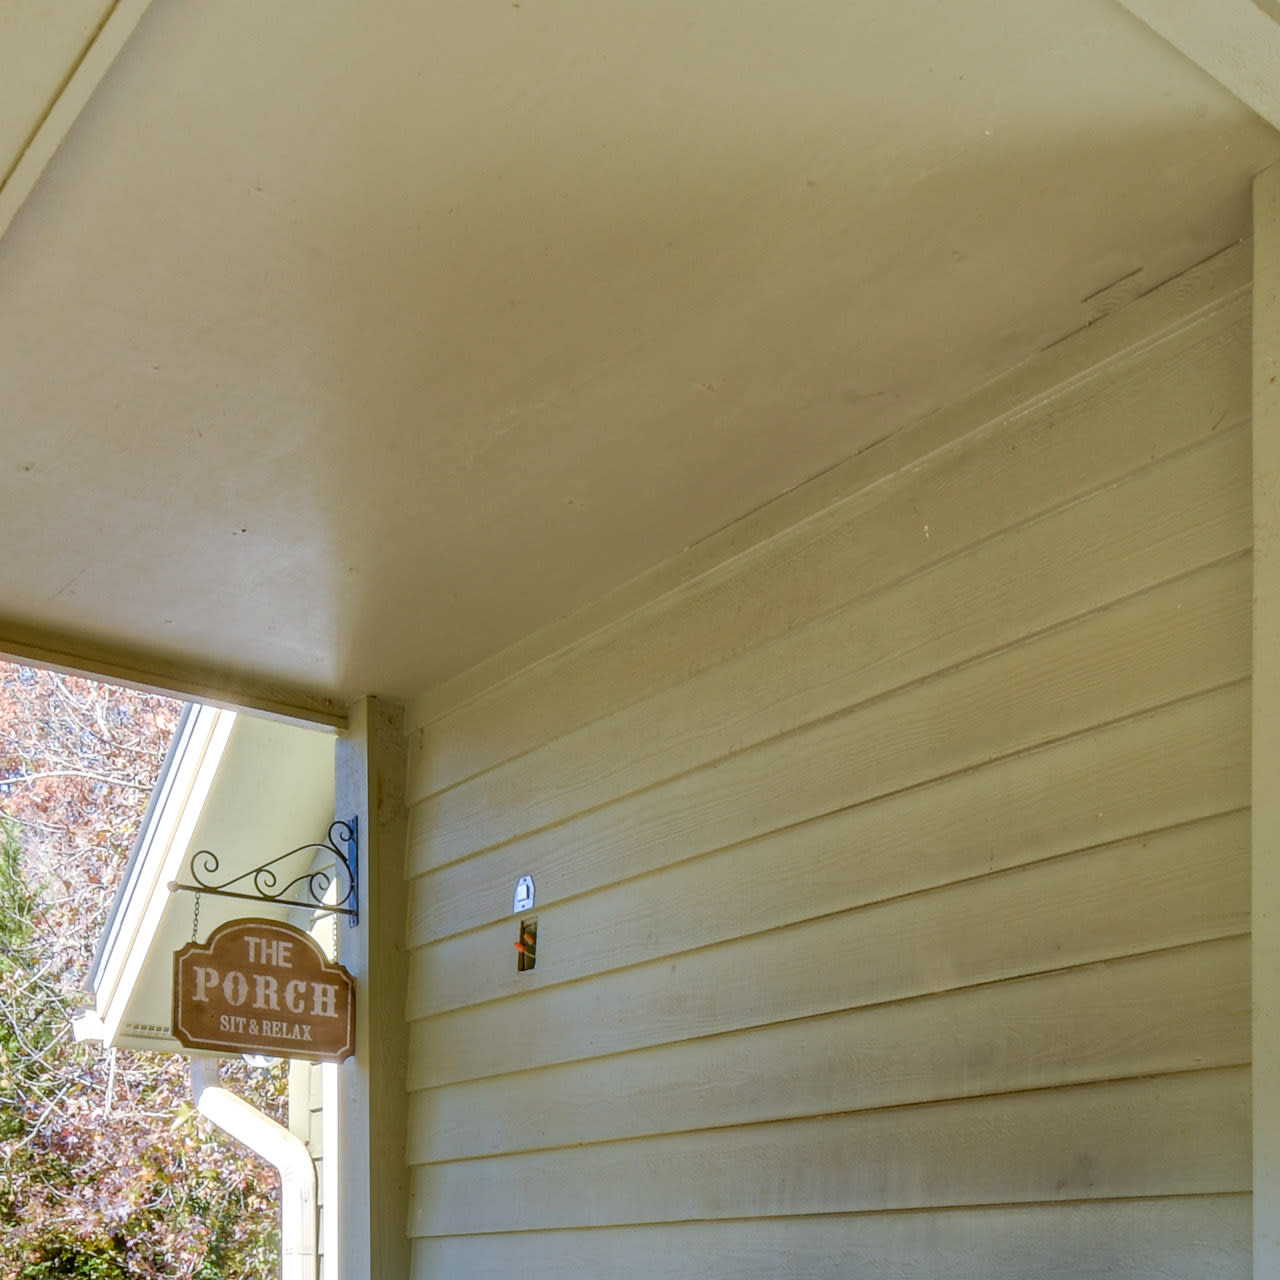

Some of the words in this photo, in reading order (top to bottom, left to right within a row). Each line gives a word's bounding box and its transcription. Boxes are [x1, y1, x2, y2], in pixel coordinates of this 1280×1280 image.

[244, 936, 293, 968] THE
[192, 966, 339, 1018] PORCH
[220, 1015, 247, 1033] SIT
[249, 1019, 259, 1036] &
[262, 1021, 312, 1041] RELAX
